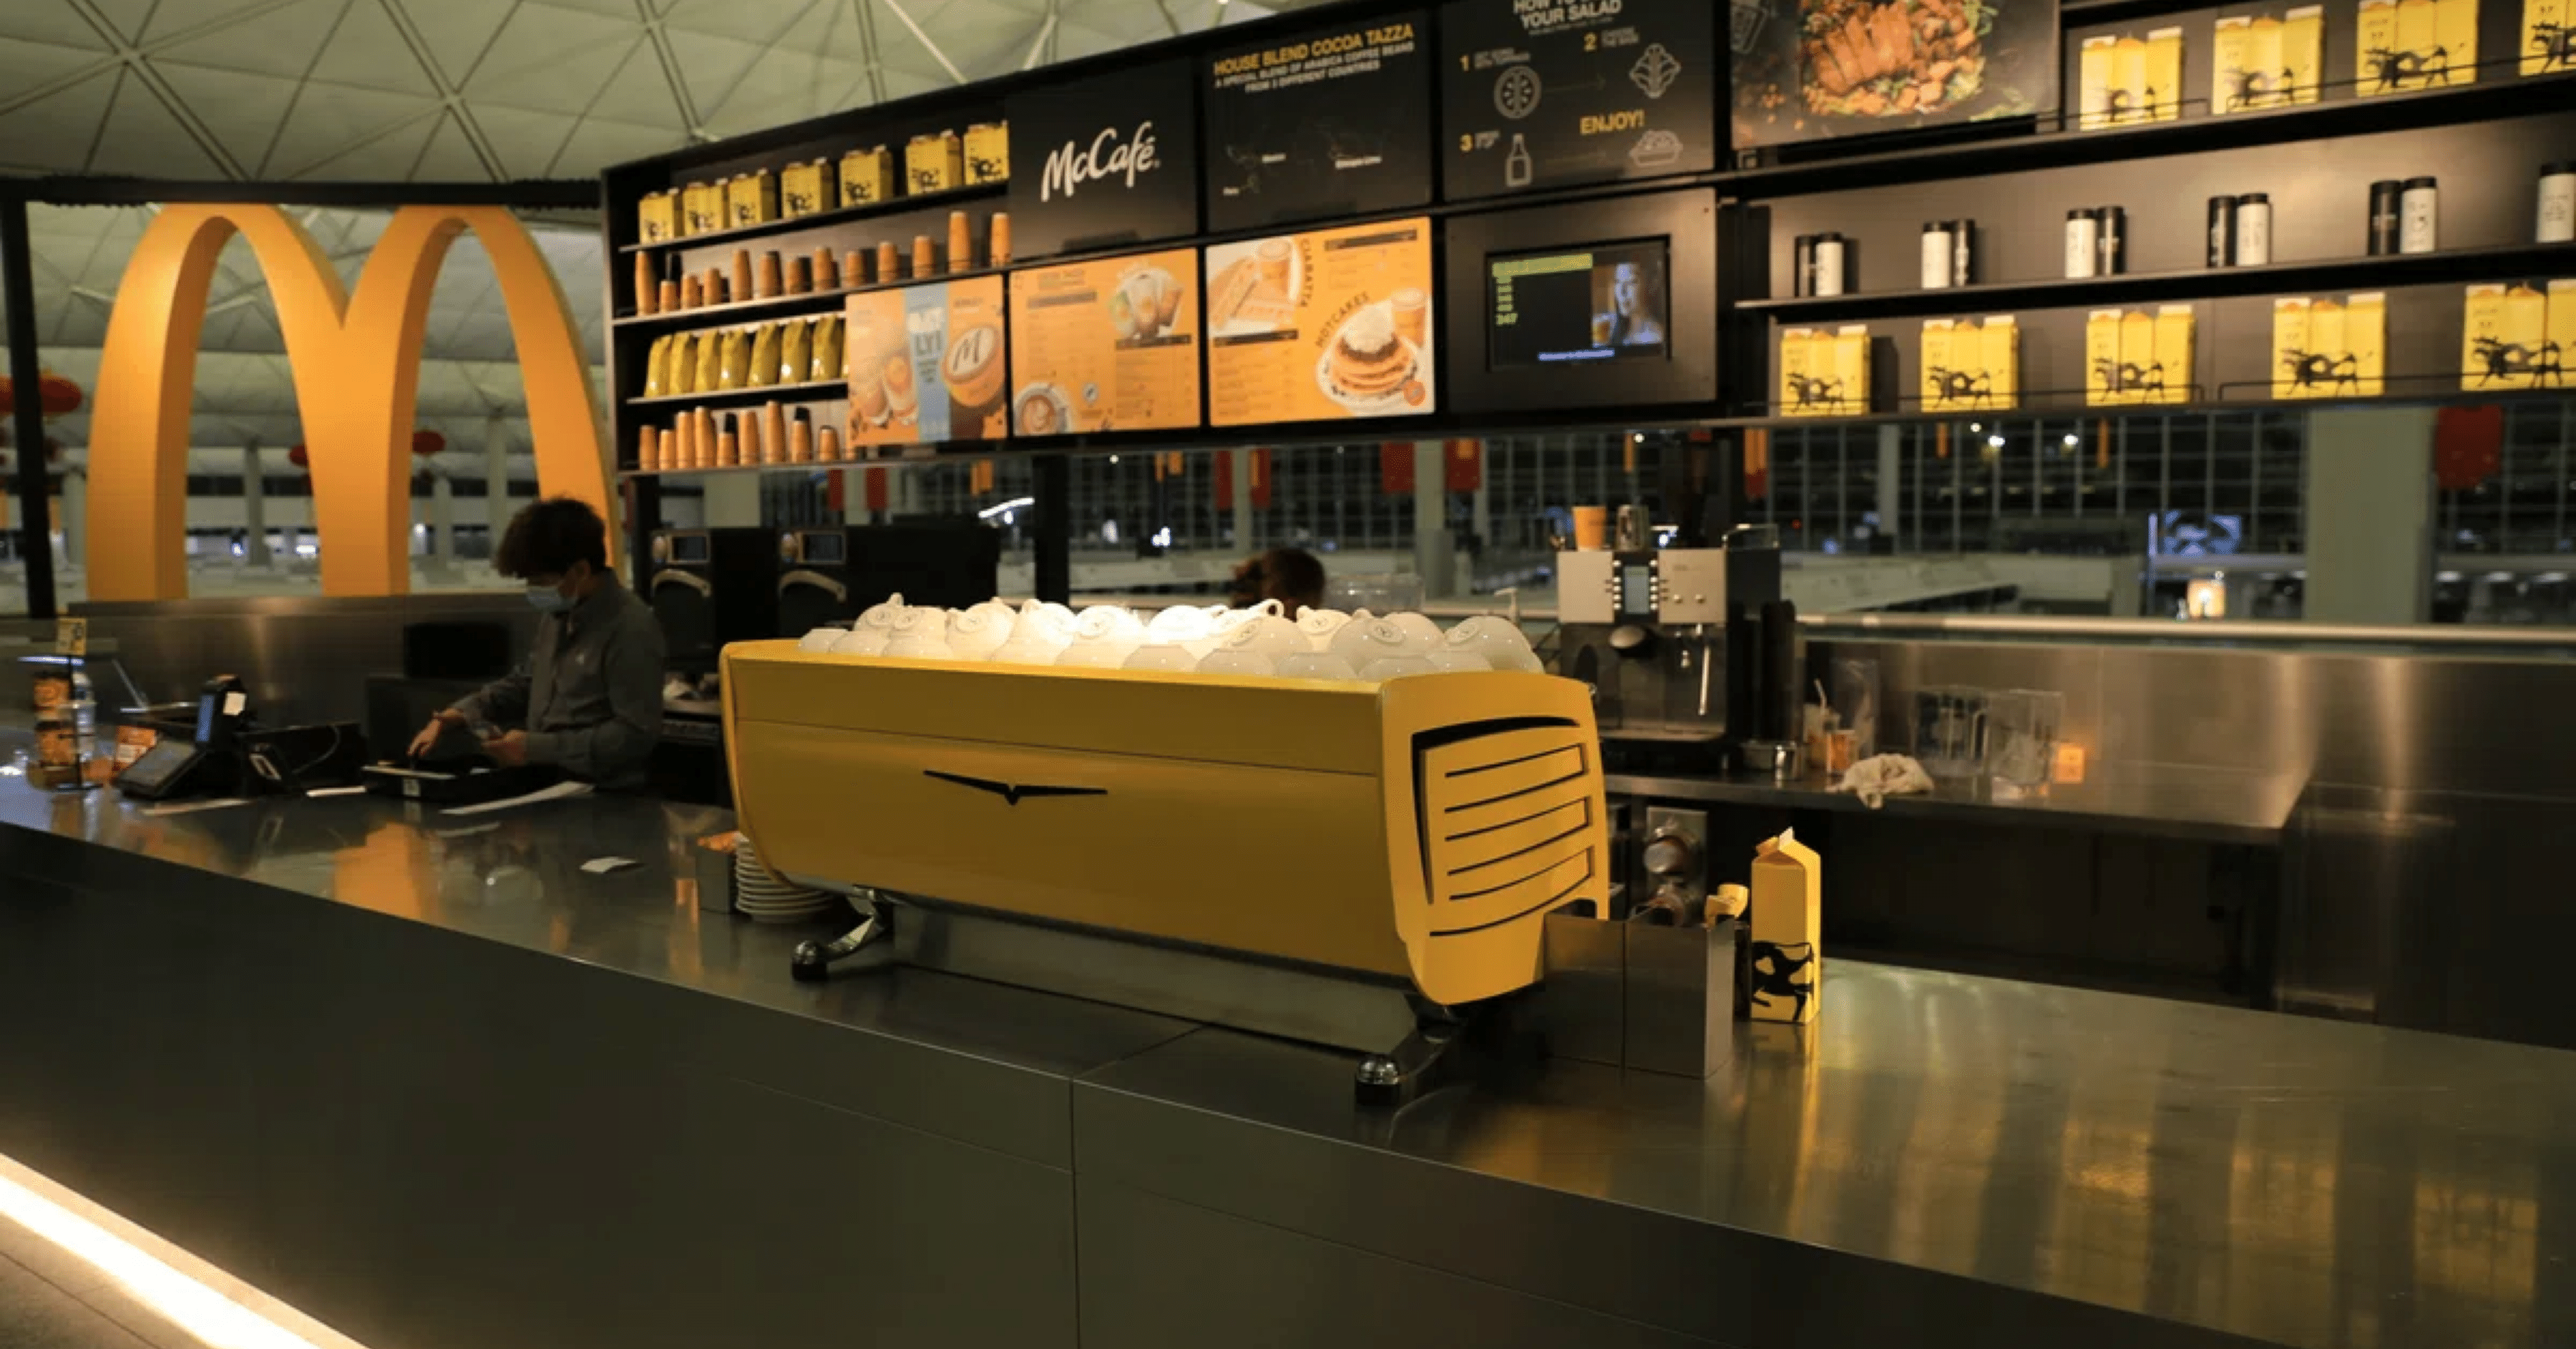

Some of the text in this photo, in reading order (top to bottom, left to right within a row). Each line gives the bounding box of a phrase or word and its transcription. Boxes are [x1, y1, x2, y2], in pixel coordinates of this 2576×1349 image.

[1520, 8, 1565, 30] YOUR
[1568, 0, 1622, 21] SALAD
[1213, 23, 1415, 76] HOUSE BLEND COCOA TAZZA
[1584, 32, 1597, 52] 2
[1460, 54, 1469, 72] 1
[1579, 109, 1644, 136] ENJOY!
[1460, 133, 1473, 152] 3
[1041, 120, 1157, 203] McCafé
[1314, 290, 1370, 349] HOTCAKES
